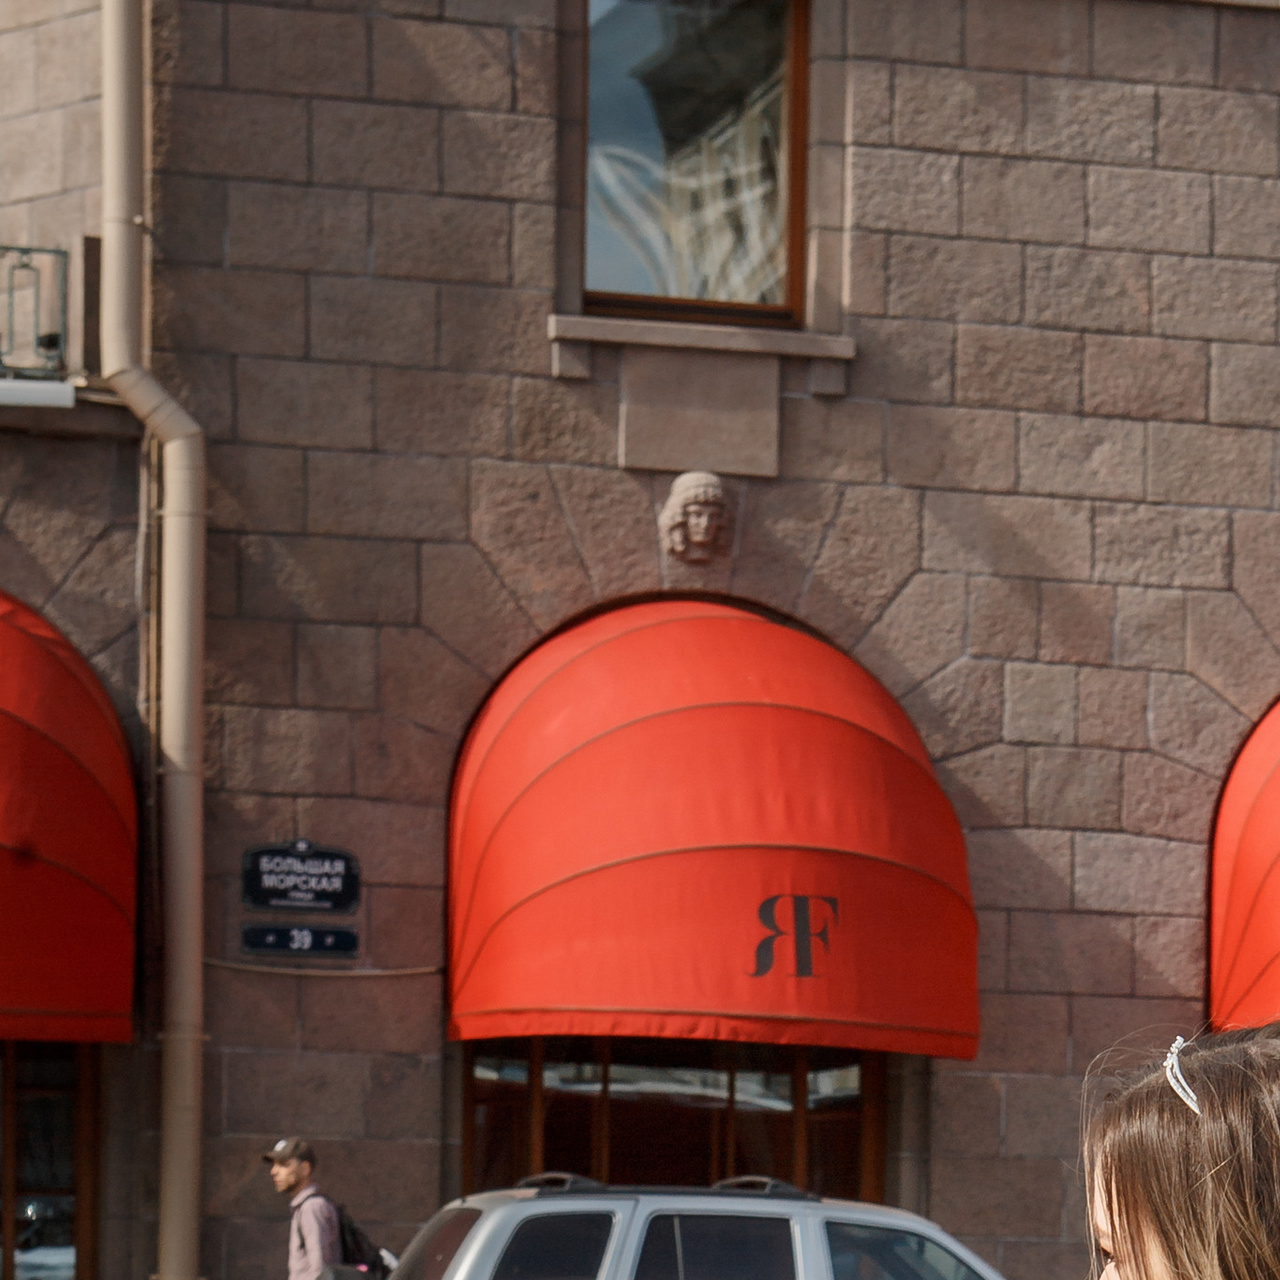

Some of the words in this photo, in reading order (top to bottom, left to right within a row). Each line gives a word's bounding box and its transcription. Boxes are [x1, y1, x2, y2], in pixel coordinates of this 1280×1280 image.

[259, 855, 345, 875] БОЛЬШАЯ
[262, 874, 342, 891] МОРСКАЯ
[289, 928, 313, 949] 39
